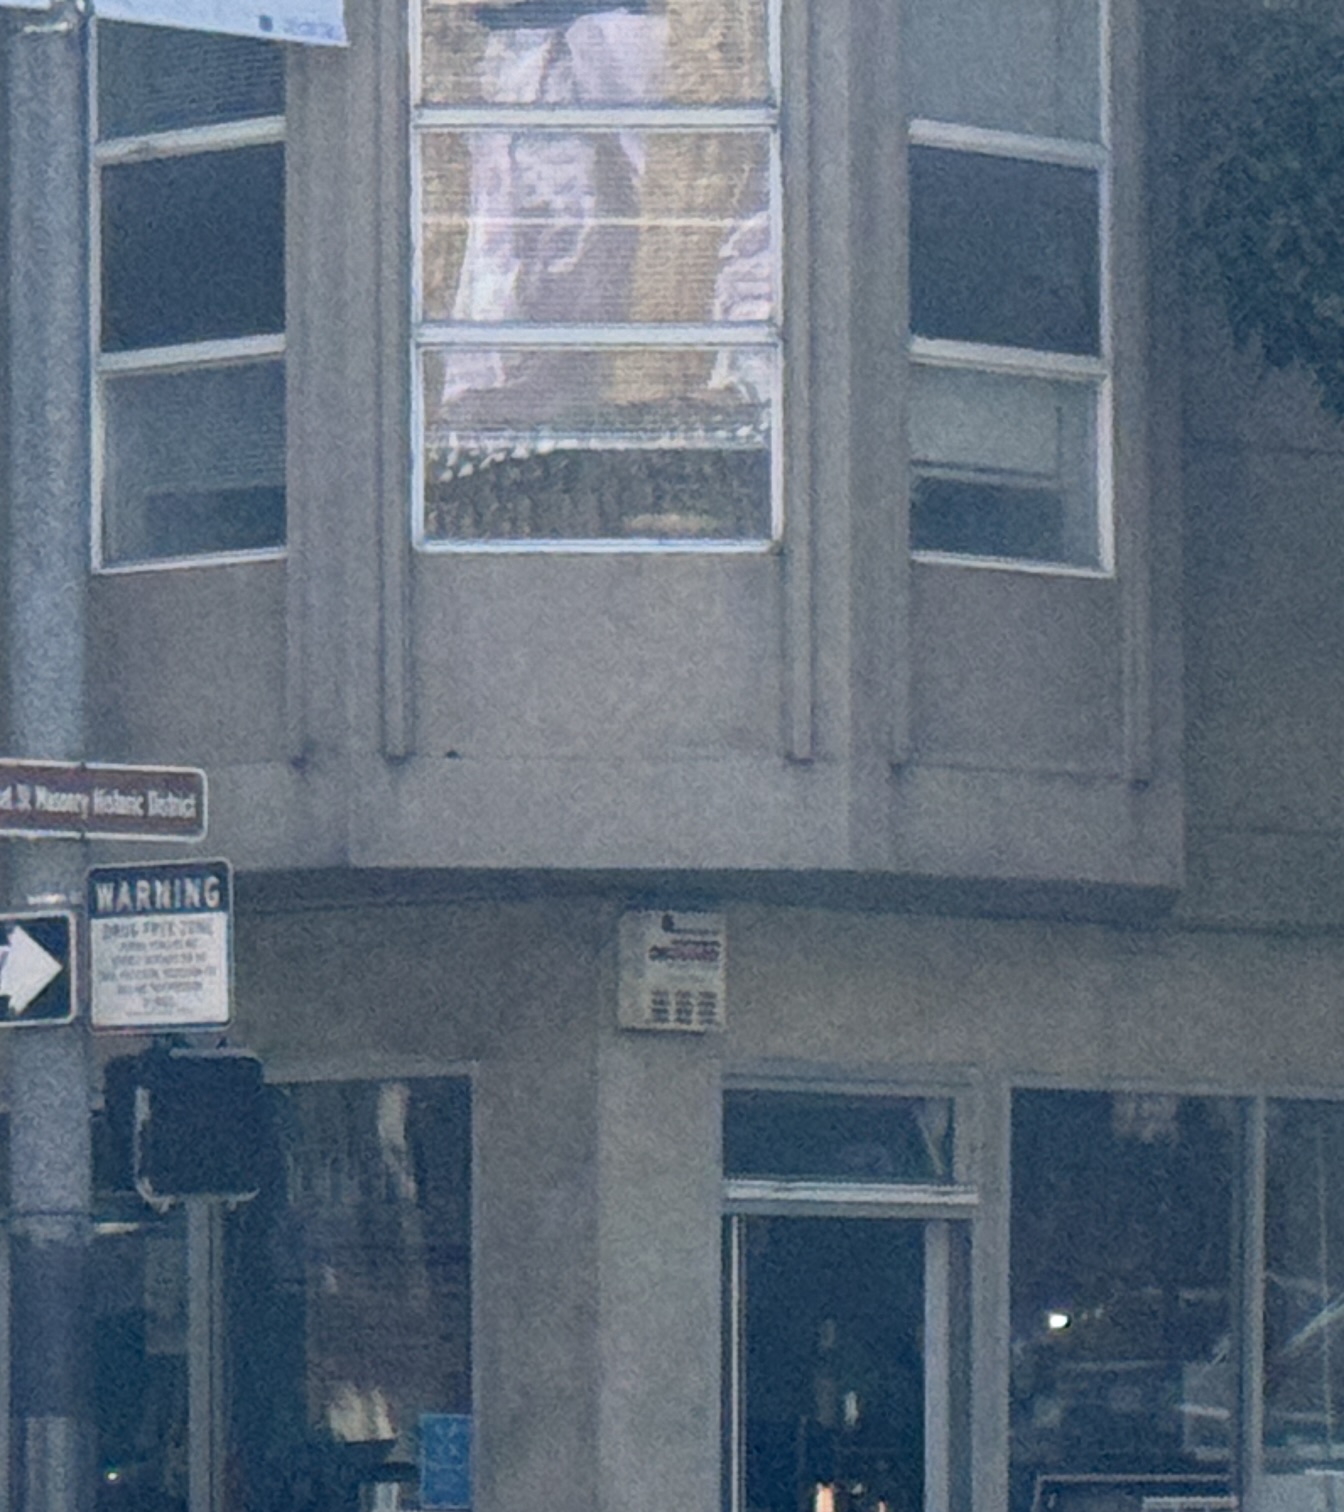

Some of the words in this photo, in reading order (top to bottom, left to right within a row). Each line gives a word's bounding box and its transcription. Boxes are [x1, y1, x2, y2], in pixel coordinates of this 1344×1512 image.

[93, 787, 145, 816] Historic
[147, 790, 197, 818] District
[95, 876, 220, 912] WARNING
